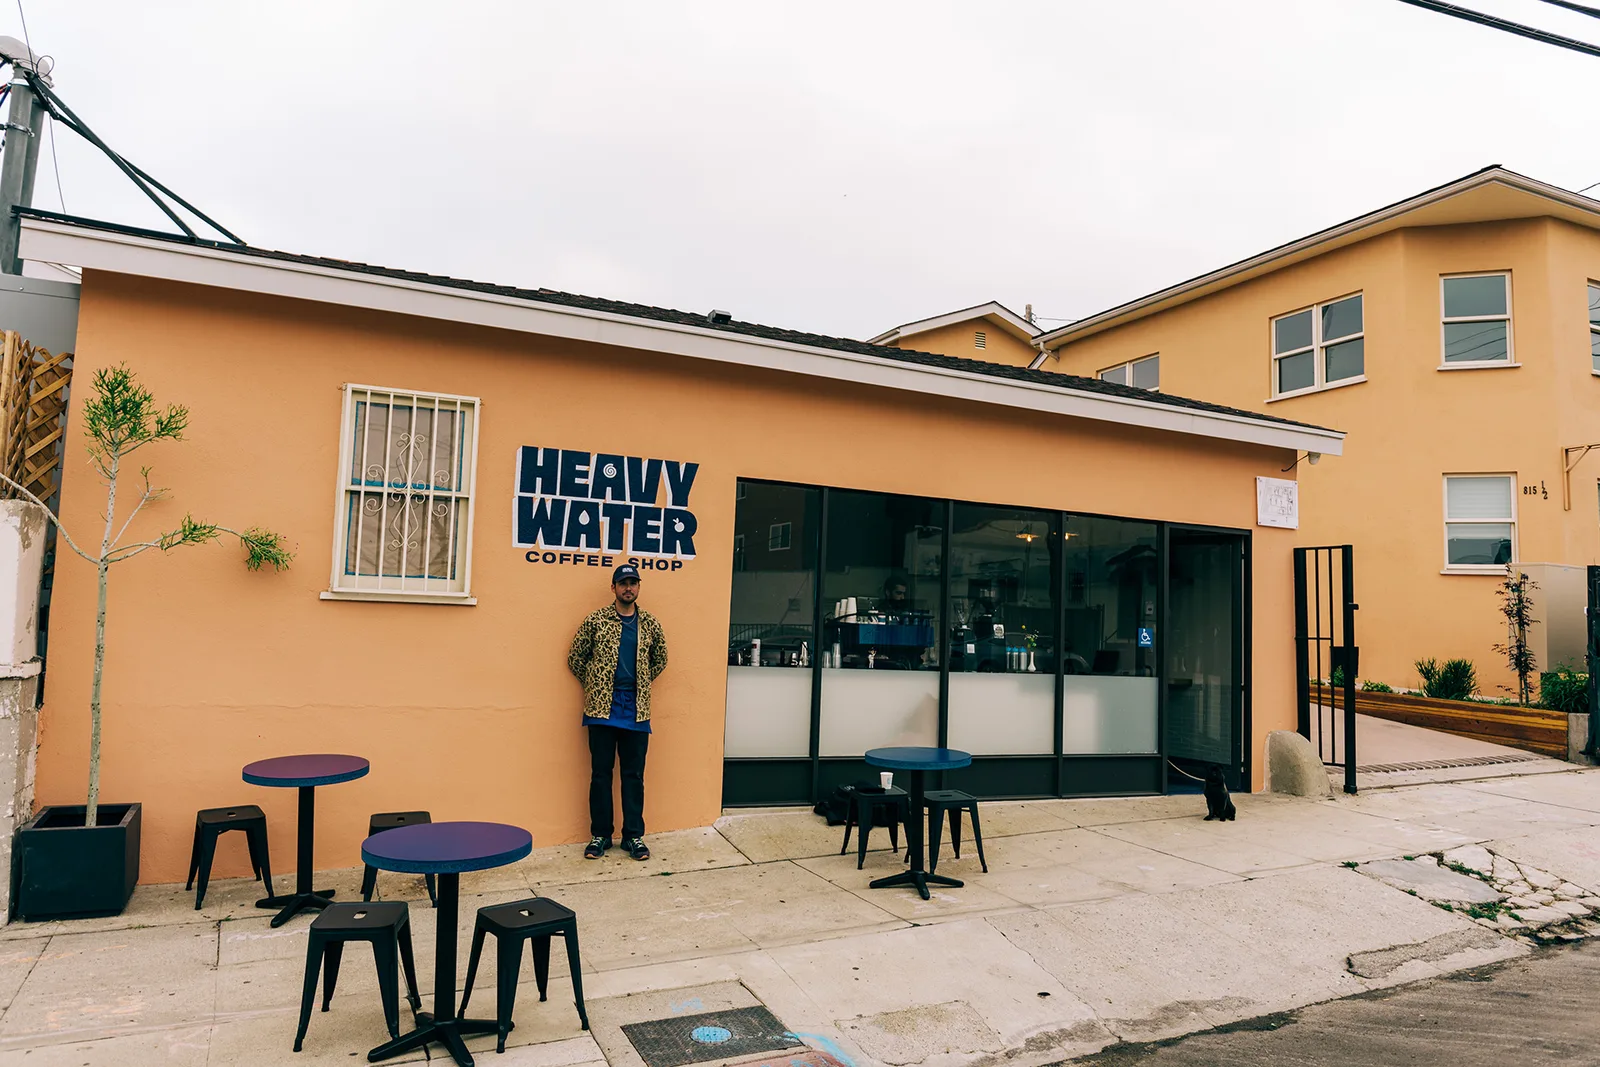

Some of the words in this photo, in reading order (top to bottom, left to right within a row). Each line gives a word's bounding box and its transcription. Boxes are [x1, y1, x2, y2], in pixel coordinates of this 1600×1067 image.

[515, 446, 699, 508] HEAVY
[1523, 486, 1537, 495] 815
[514, 496, 698, 557] WATER
[525, 551, 613, 567] COFFEE
[628, 558, 683, 571] SHOP
